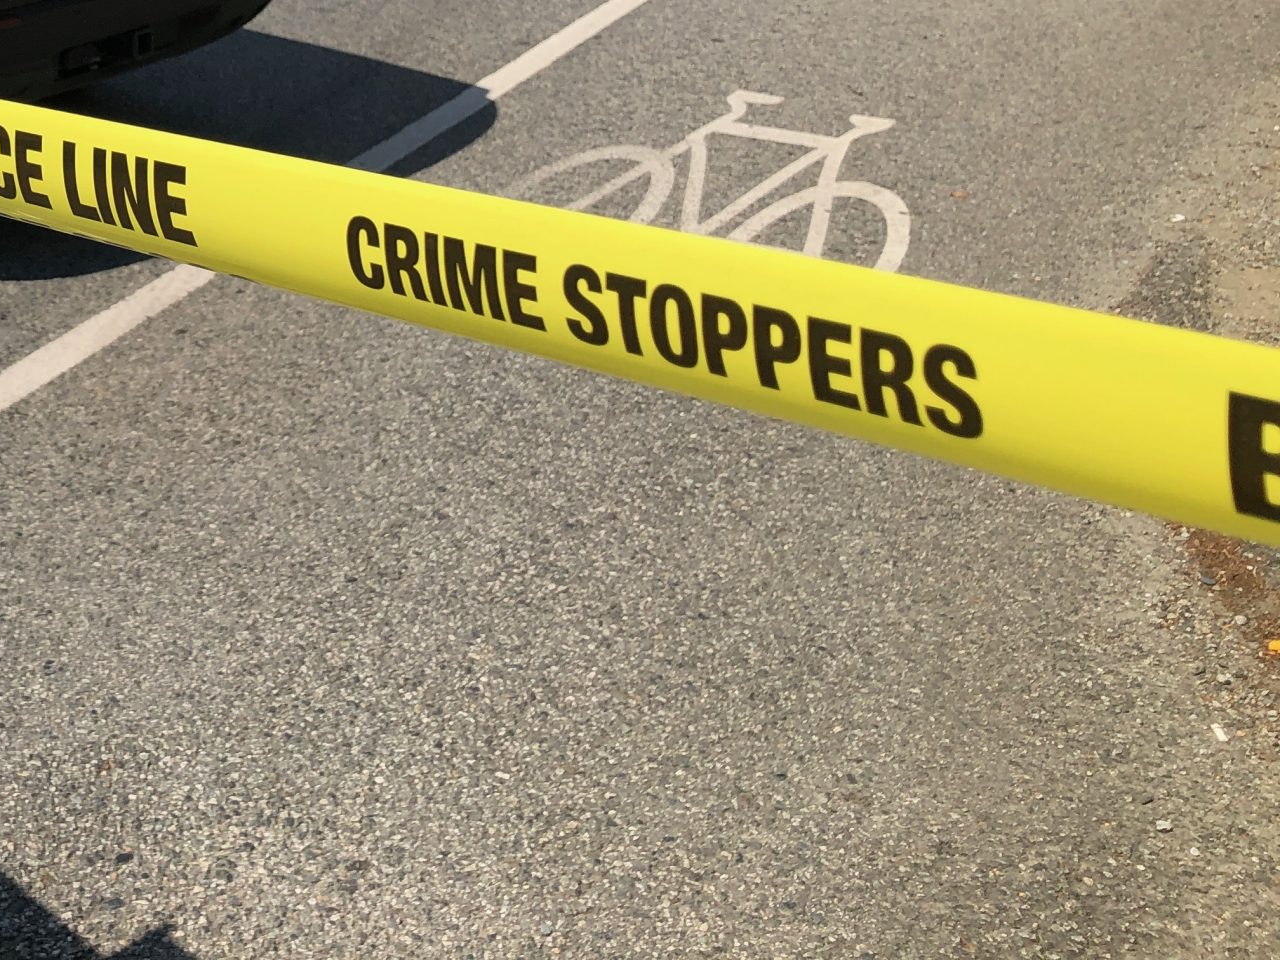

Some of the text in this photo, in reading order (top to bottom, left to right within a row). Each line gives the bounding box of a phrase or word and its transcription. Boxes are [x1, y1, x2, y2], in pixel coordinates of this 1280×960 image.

[62, 140, 198, 248] LINE
[346, 214, 984, 440] CRIME STOPPERS
